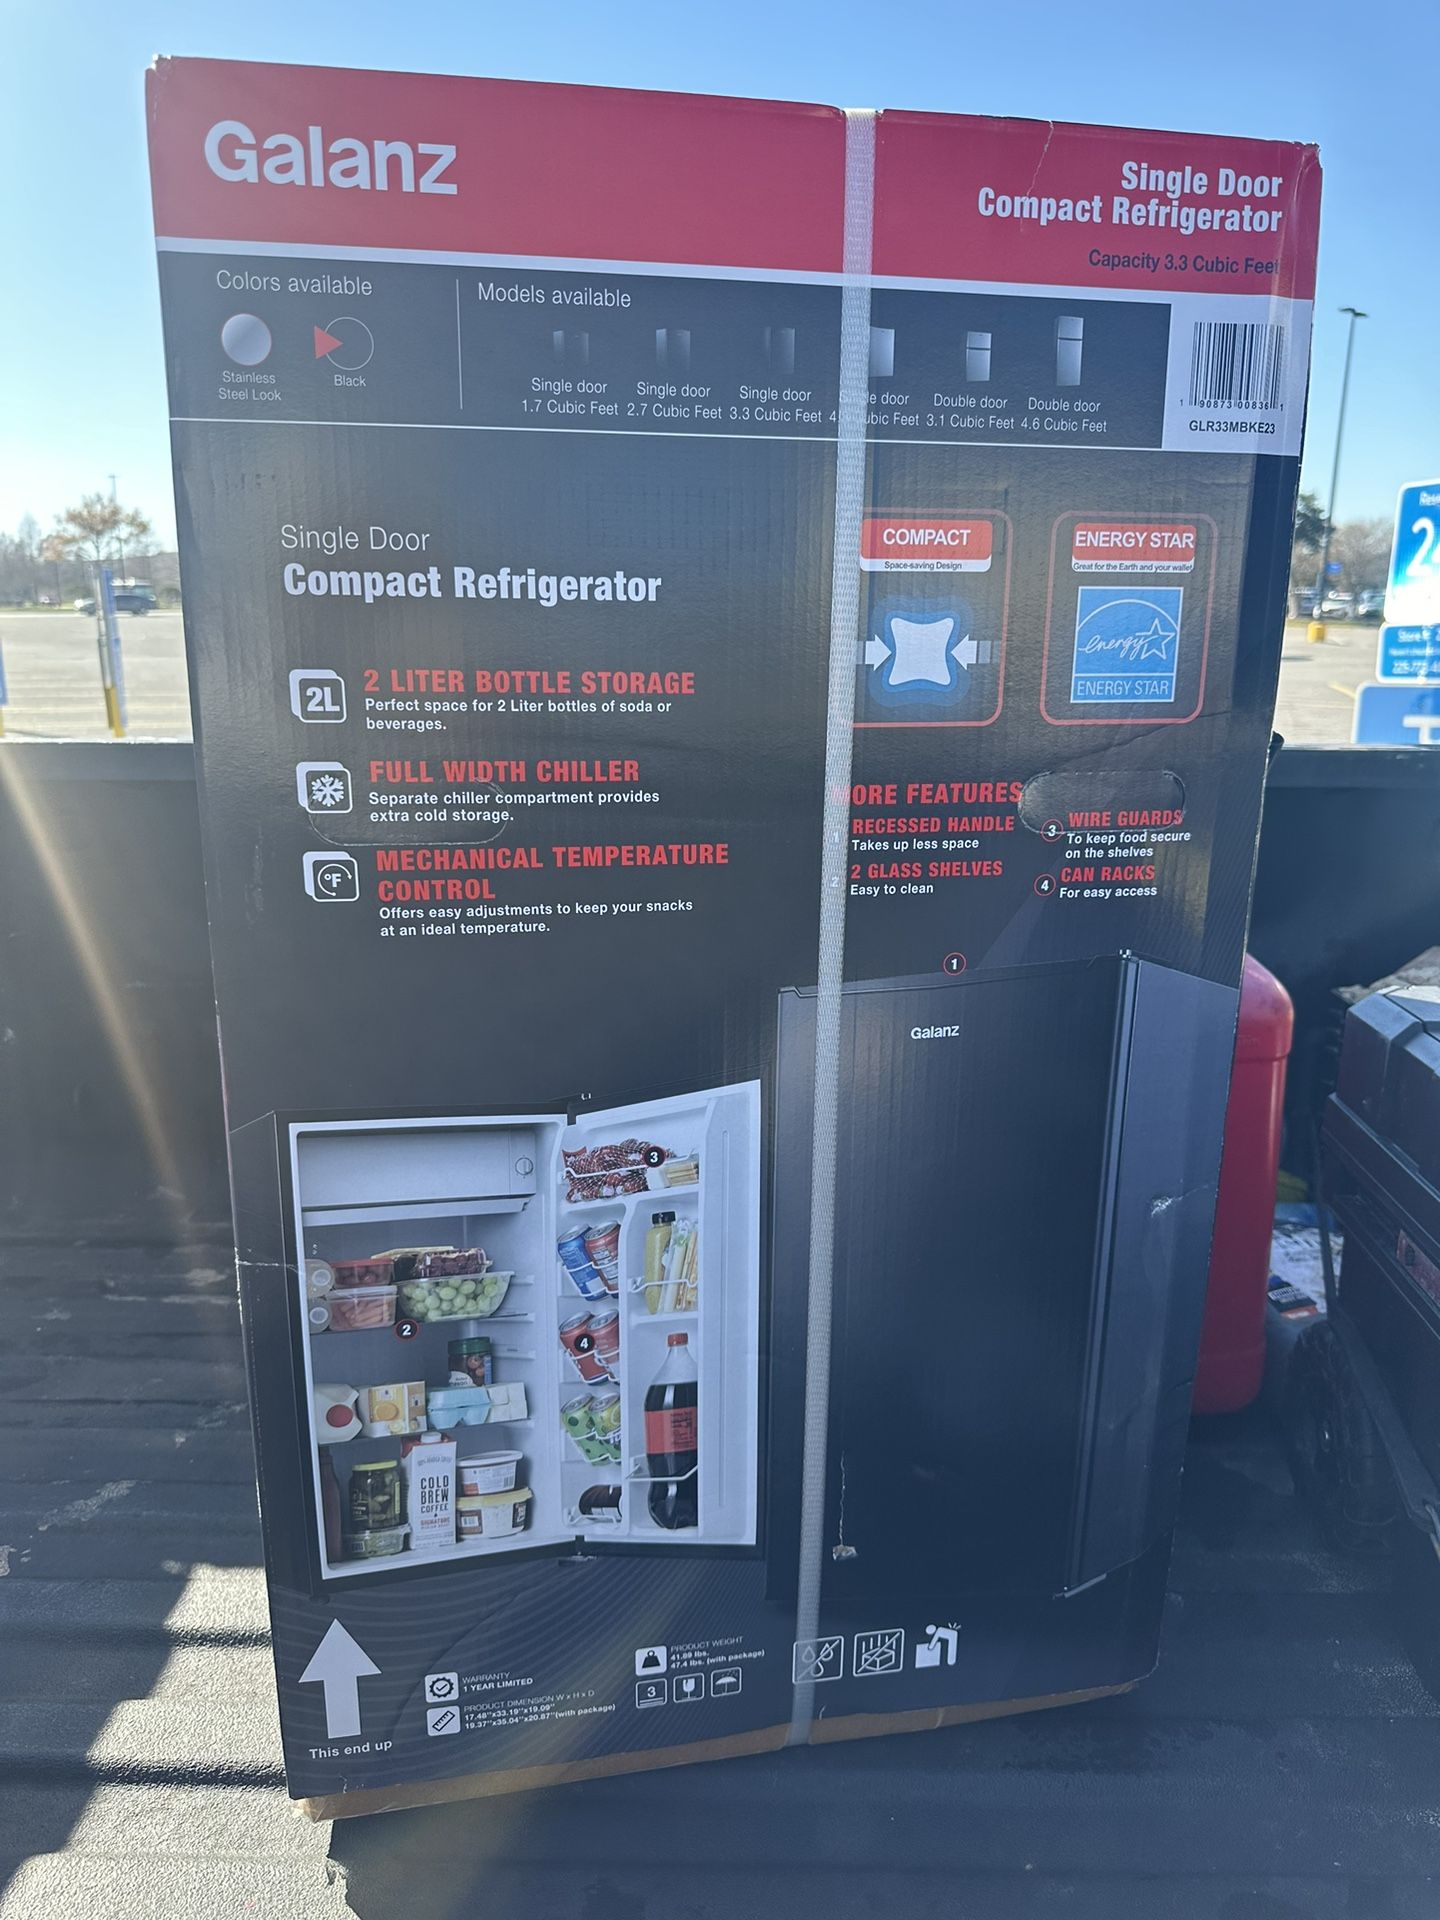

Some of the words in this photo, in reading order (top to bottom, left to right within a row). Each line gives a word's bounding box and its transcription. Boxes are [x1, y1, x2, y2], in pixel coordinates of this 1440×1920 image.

[204, 119, 458, 195] Galanz
[1122, 161, 1208, 198] Single
[1218, 168, 1284, 199] Door
[978, 188, 1102, 224] Compact
[1112, 197, 1284, 235] Refrigerator
[1088, 249, 1160, 274] Capacity
[1164, 253, 1188, 271] 3.3
[1192, 254, 1237, 274] Cubic
[1240, 256, 1281, 275] Feet
[216, 269, 281, 293] Colors
[288, 272, 373, 297] available
[478, 282, 545, 305] Models
[551, 284, 632, 309] available
[222, 370, 276, 385] Stainless
[333, 373, 367, 388] Black
[531, 377, 573, 396] Single
[575, 379, 608, 394] door
[218, 386, 246, 401] Steel
[249, 388, 282, 402] Look
[637, 381, 676, 400] Single
[679, 382, 711, 399] door
[739, 385, 778, 403] Single
[782, 387, 811, 403] door
[881, 391, 909, 406] door
[521, 400, 544, 414] 1.7
[548, 399, 585, 415] Cubic
[588, 401, 619, 416] Feet
[934, 393, 975, 409] Double
[979, 395, 1008, 410] door
[1028, 397, 1070, 413] Double
[1073, 399, 1101, 414] door
[1199, 400, 1232, 409] 90873
[1237, 401, 1270, 411] 00836
[627, 402, 650, 416] 2.7
[652, 402, 689, 418] Cubic
[690, 404, 722, 420] Feet
[729, 405, 750, 420] 3.3
[754, 406, 791, 422] Cubic
[795, 408, 822, 423] Feet
[893, 411, 919, 426] Feet
[926, 413, 945, 428] 3.1
[949, 413, 986, 430] Cubic
[987, 415, 1015, 431] Feet
[1021, 416, 1041, 431] 4.6
[1044, 416, 1079, 433] Cubic
[1082, 418, 1107, 434] Feet
[1188, 419, 1276, 434] GLR33MBKE23
[280, 524, 360, 556] Single
[369, 526, 430, 551] Door
[883, 528, 971, 546] COMPACT
[1075, 531, 1147, 548] ENERGY
[1150, 532, 1194, 548] STAR
[884, 560, 935, 571] Space-saving
[936, 561, 963, 571] Design
[1073, 562, 1093, 571] Great
[1106, 563, 1118, 571] the
[1119, 563, 1138, 571] Earth
[1139, 563, 1153, 572] and
[283, 562, 442, 603] Compact
[453, 566, 662, 607] Refrigerator
[1078, 634, 1154, 660] energy
[364, 669, 382, 693] 2
[390, 669, 465, 693] LITER
[475, 670, 571, 694] BOTTLE
[580, 671, 696, 695] STORAGE
[1077, 680, 1131, 696] ENERGY
[1134, 680, 1168, 695] STAR
[304, 685, 340, 712] 2L
[365, 698, 420, 713] Perfect
[423, 701, 469, 716] space
[472, 698, 494, 713] for
[497, 699, 507, 713] 2
[510, 699, 544, 713] Liter
[547, 699, 598, 714] bottles
[601, 699, 617, 713] of
[618, 699, 653, 714] soda
[656, 702, 672, 714] or
[366, 717, 447, 733] beverages.
[370, 761, 434, 783] FULL
[443, 760, 527, 783] WIDTH
[536, 760, 640, 782] CHILLER
[369, 791, 438, 809] Separate
[443, 790, 492, 806] chiller
[495, 791, 594, 808] compartment
[598, 789, 660, 807] provides
[907, 782, 1023, 804] FEATURES
[370, 809, 410, 823] extra
[414, 808, 448, 823] cold
[451, 809, 515, 826] storage.
[852, 817, 940, 834] RECESSED
[948, 816, 1014, 832] HANDLE
[1068, 811, 1111, 828] WIRE
[1117, 809, 1184, 826] GUARDS
[852, 839, 889, 851] Takes
[893, 840, 909, 853] up
[913, 838, 938, 850] less
[942, 839, 979, 852] space
[1066, 833, 1082, 844] To
[1086, 832, 1116, 846] keep
[1119, 831, 1147, 844] food
[1150, 832, 1191, 843] secure
[376, 847, 543, 871] MECHANICAL
[552, 844, 729, 868] TEMPERATURE
[1065, 849, 1080, 859] on
[1084, 847, 1104, 858] the
[1107, 846, 1154, 858] shelves
[851, 864, 861, 879] 2
[867, 863, 922, 879] GLASS
[928, 860, 1003, 877] SHELVES
[1060, 867, 1095, 883] CAN
[1101, 864, 1156, 881] RACKS
[378, 878, 496, 901] CONTROL
[851, 884, 880, 898] Easy
[884, 884, 896, 896] to
[900, 883, 934, 895] clean
[1059, 887, 1080, 899] For
[1083, 887, 1112, 900] easy
[1115, 886, 1158, 897] access
[379, 906, 424, 921] Offers
[428, 906, 462, 923] easy
[466, 902, 552, 920] adjustments
[556, 902, 571, 916] to
[575, 900, 609, 918] keep
[612, 901, 642, 916] your
[646, 898, 693, 914] snacks
[381, 923, 395, 937] at
[399, 924, 417, 937] an
[420, 921, 456, 936] ideal
[460, 920, 550, 939] temperature.
[910, 1023, 960, 1041] Galanz
[402, 1324, 412, 1337] 2
[580, 1338, 589, 1349] 4
[420, 1475, 449, 1490] COLD
[420, 1488, 449, 1505] BREW
[420, 1503, 449, 1514] COFFEE
[670, 1641, 710, 1653] PRODUCT
[712, 1636, 744, 1649] WEIGHT
[462, 1671, 511, 1684] WARRANTY
[471, 1682, 495, 1692] YEAR
[497, 1677, 534, 1690] LIMITED
[464, 1700, 505, 1713] PRODUCT
[507, 1695, 554, 1708] DIMENSION
[578, 1703, 617, 1717] package)
[309, 1747, 340, 1760] This
[344, 1743, 371, 1756] end
[375, 1740, 393, 1755] up
